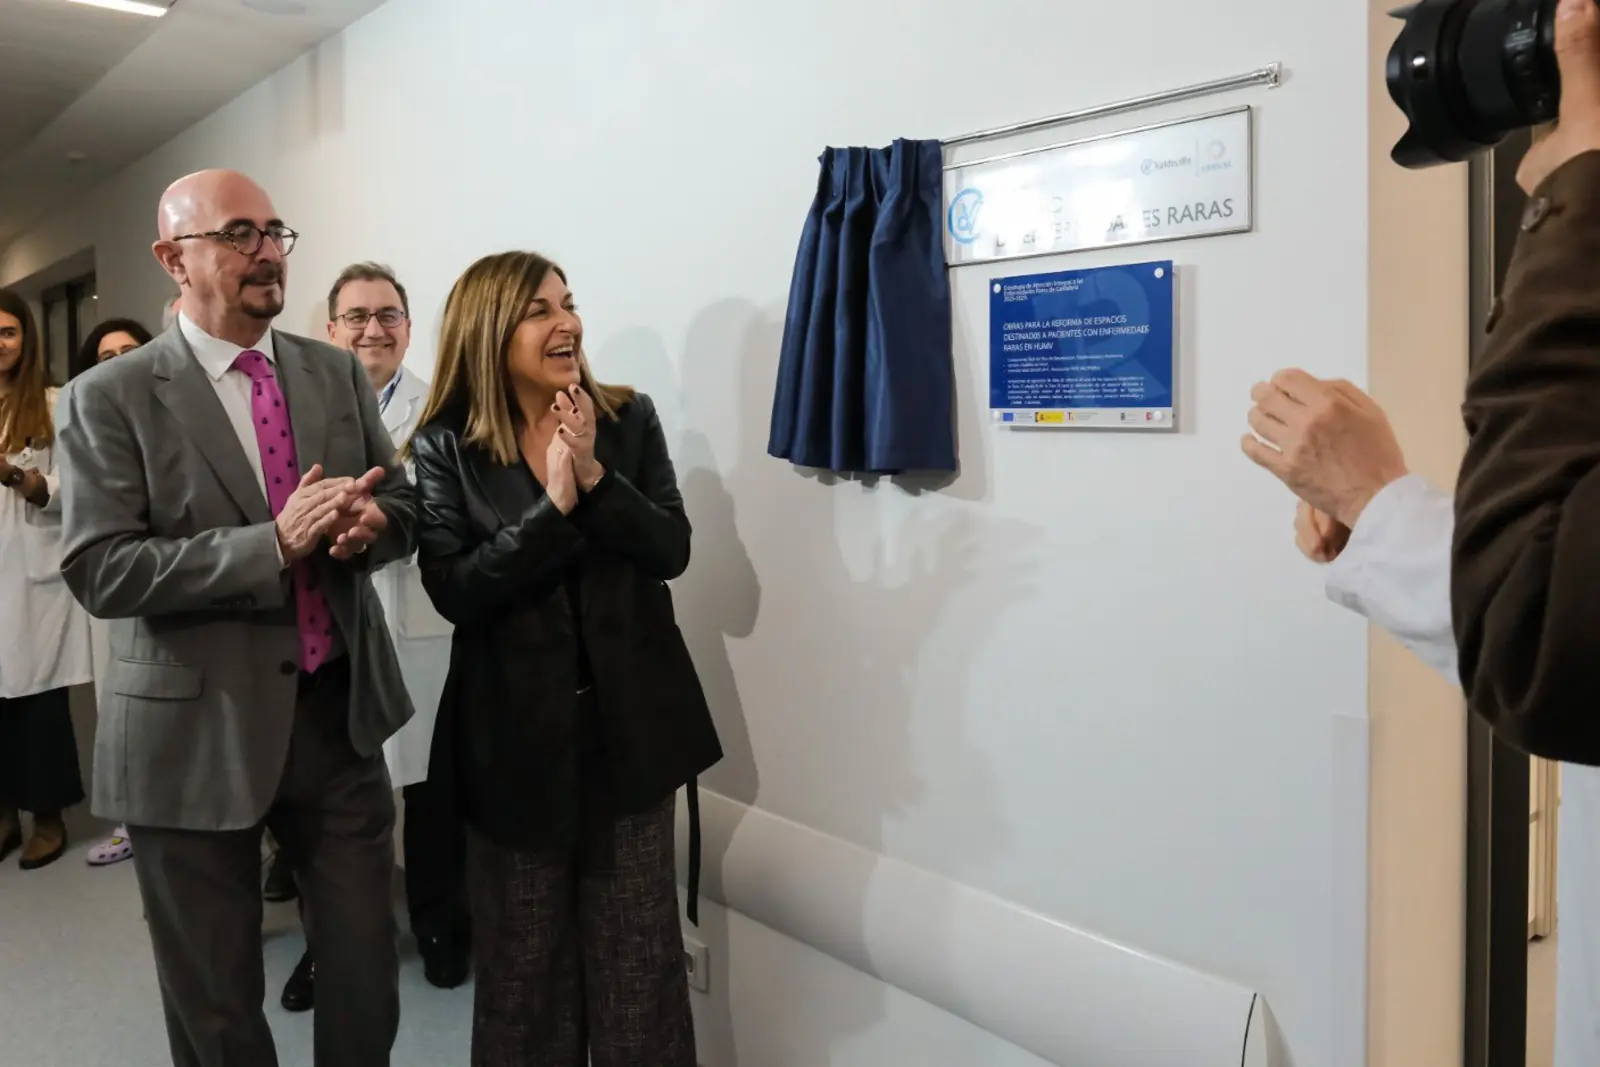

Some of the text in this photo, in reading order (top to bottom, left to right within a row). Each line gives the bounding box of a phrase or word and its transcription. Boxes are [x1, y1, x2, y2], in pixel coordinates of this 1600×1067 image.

[1167, 198, 1234, 225] RARAS
[1003, 314, 1128, 331] OBRAS PARA LA REFORMA DE ESPACIOS
[1003, 332, 1041, 341] DESTINADOS
[1048, 329, 1082, 339] PACIENTES
[1083, 328, 1098, 337] CON
[1003, 342, 1054, 351] RARAS EN HUMV
